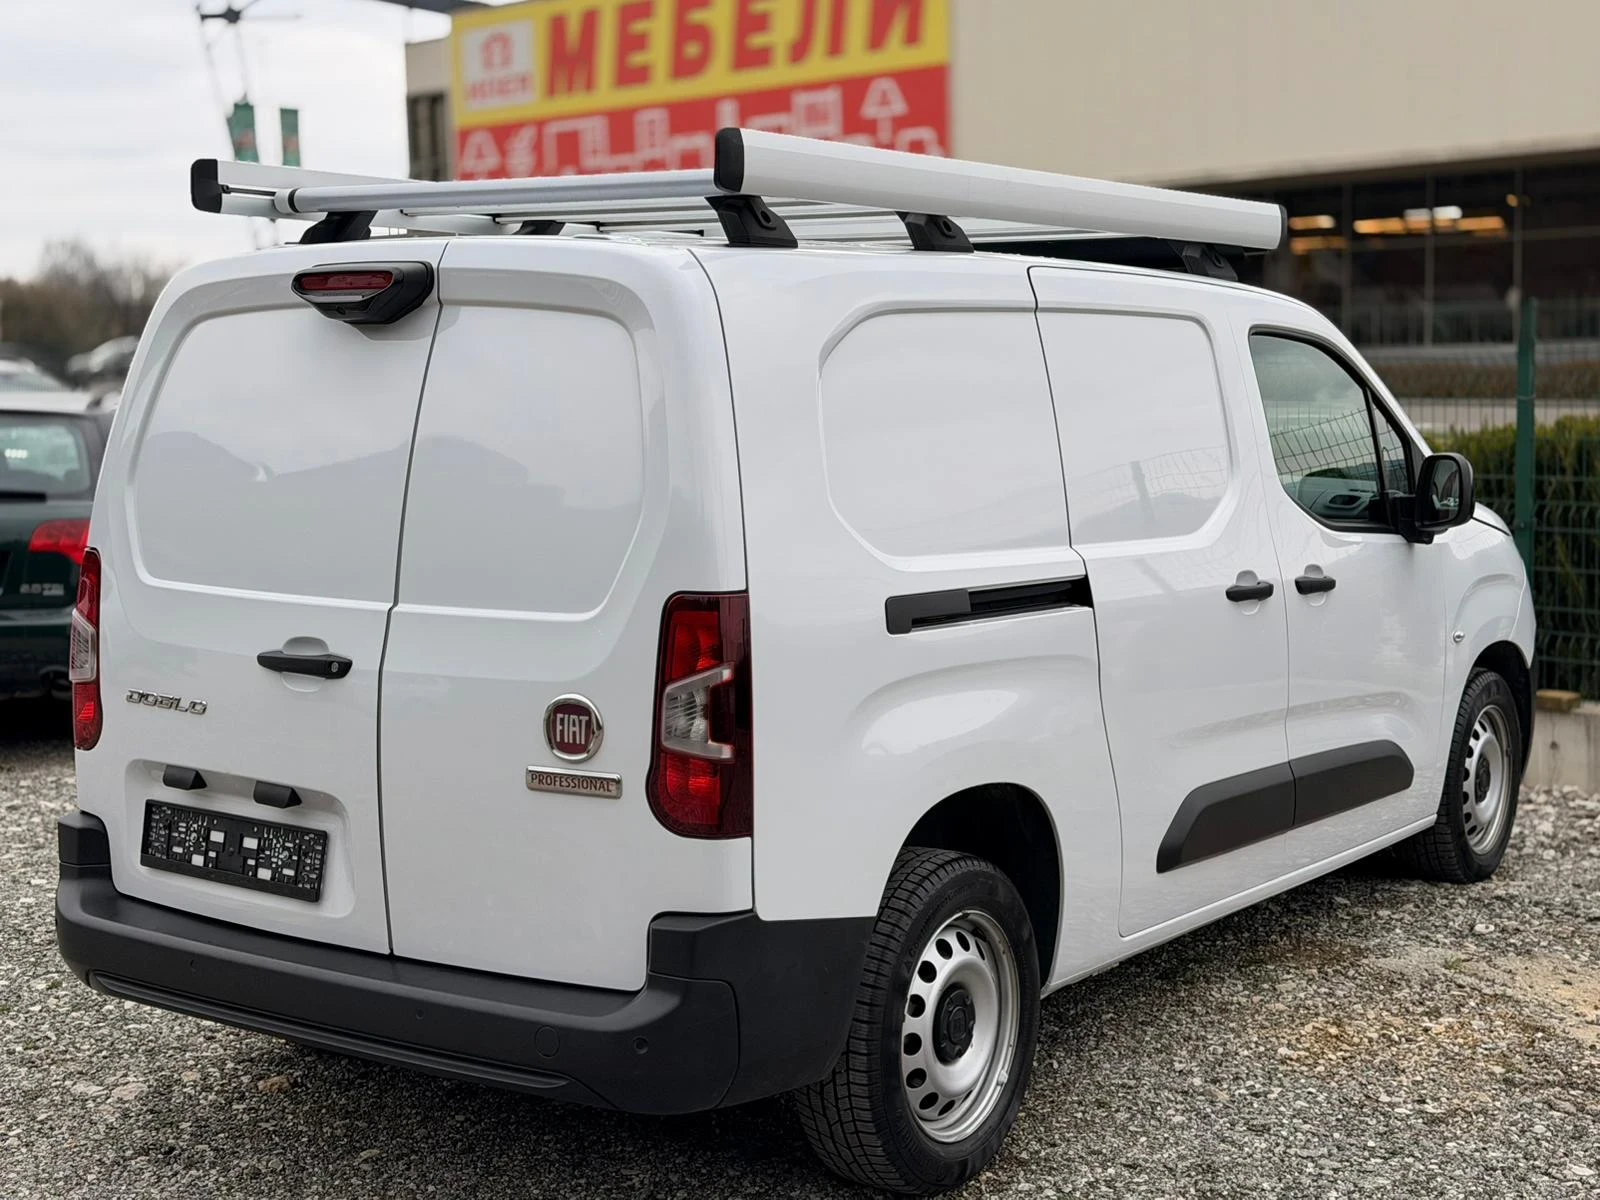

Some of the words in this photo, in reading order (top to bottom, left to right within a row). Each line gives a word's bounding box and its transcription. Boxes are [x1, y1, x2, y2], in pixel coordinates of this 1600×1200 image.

[547, 0, 925, 98] МЕБЕЛИ
[556, 713, 589, 745] FIAT
[530, 773, 612, 793] PROFESSIONAL
